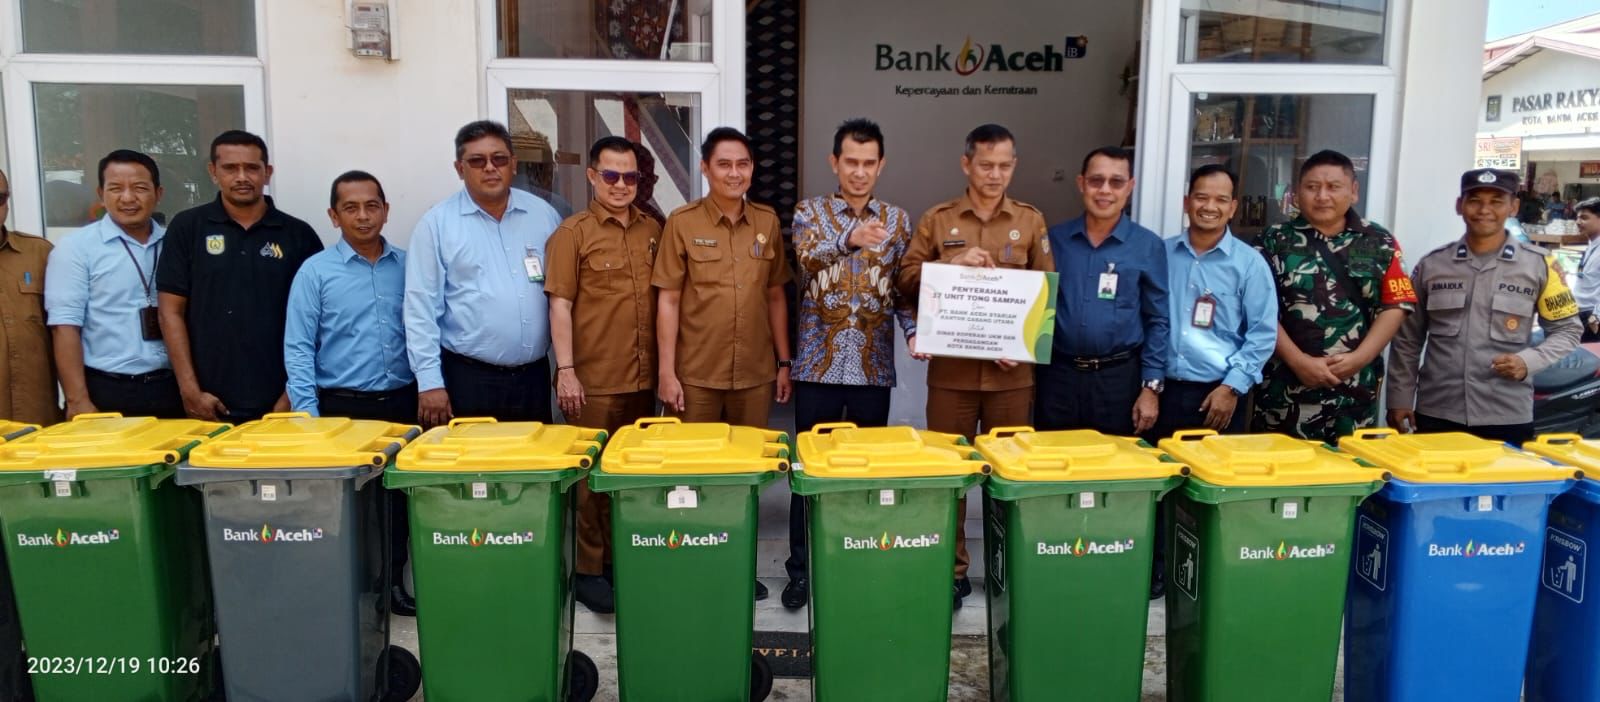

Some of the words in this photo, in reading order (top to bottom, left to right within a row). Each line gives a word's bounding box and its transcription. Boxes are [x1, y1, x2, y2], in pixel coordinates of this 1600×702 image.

[875, 44, 952, 71] Bank
[983, 44, 1064, 72] Aceh
[895, 85, 960, 97] Kepercayaan
[962, 85, 982, 95] dan
[984, 85, 1038, 95] Kemitraan
[1512, 92, 1553, 113] PASAR
[1556, 87, 1600, 109] RAKY
[1522, 116, 1542, 126] KOTA
[1547, 114, 1572, 124] BANDA
[1499, 283, 1535, 297] POLRI
[944, 293, 965, 301] UNIT
[992, 297, 1027, 305] SAMPAH
[17, 532, 55, 546] Bank
[70, 530, 110, 545] Aceh
[223, 528, 258, 542] Bank
[274, 528, 313, 542] Aceh
[432, 531, 469, 545] Bank
[484, 532, 523, 545] Aceh
[631, 534, 666, 547] Bank
[681, 533, 718, 547] Aceh
[843, 536, 879, 550] Bank
[893, 535, 930, 548] Aceh
[1036, 542, 1073, 556] Bank
[1086, 541, 1124, 554] Aceh
[1239, 545, 1275, 560] Bank
[1289, 544, 1326, 559] Aceh
[1428, 543, 1464, 557] Bank
[1477, 543, 1514, 556] Aceh
